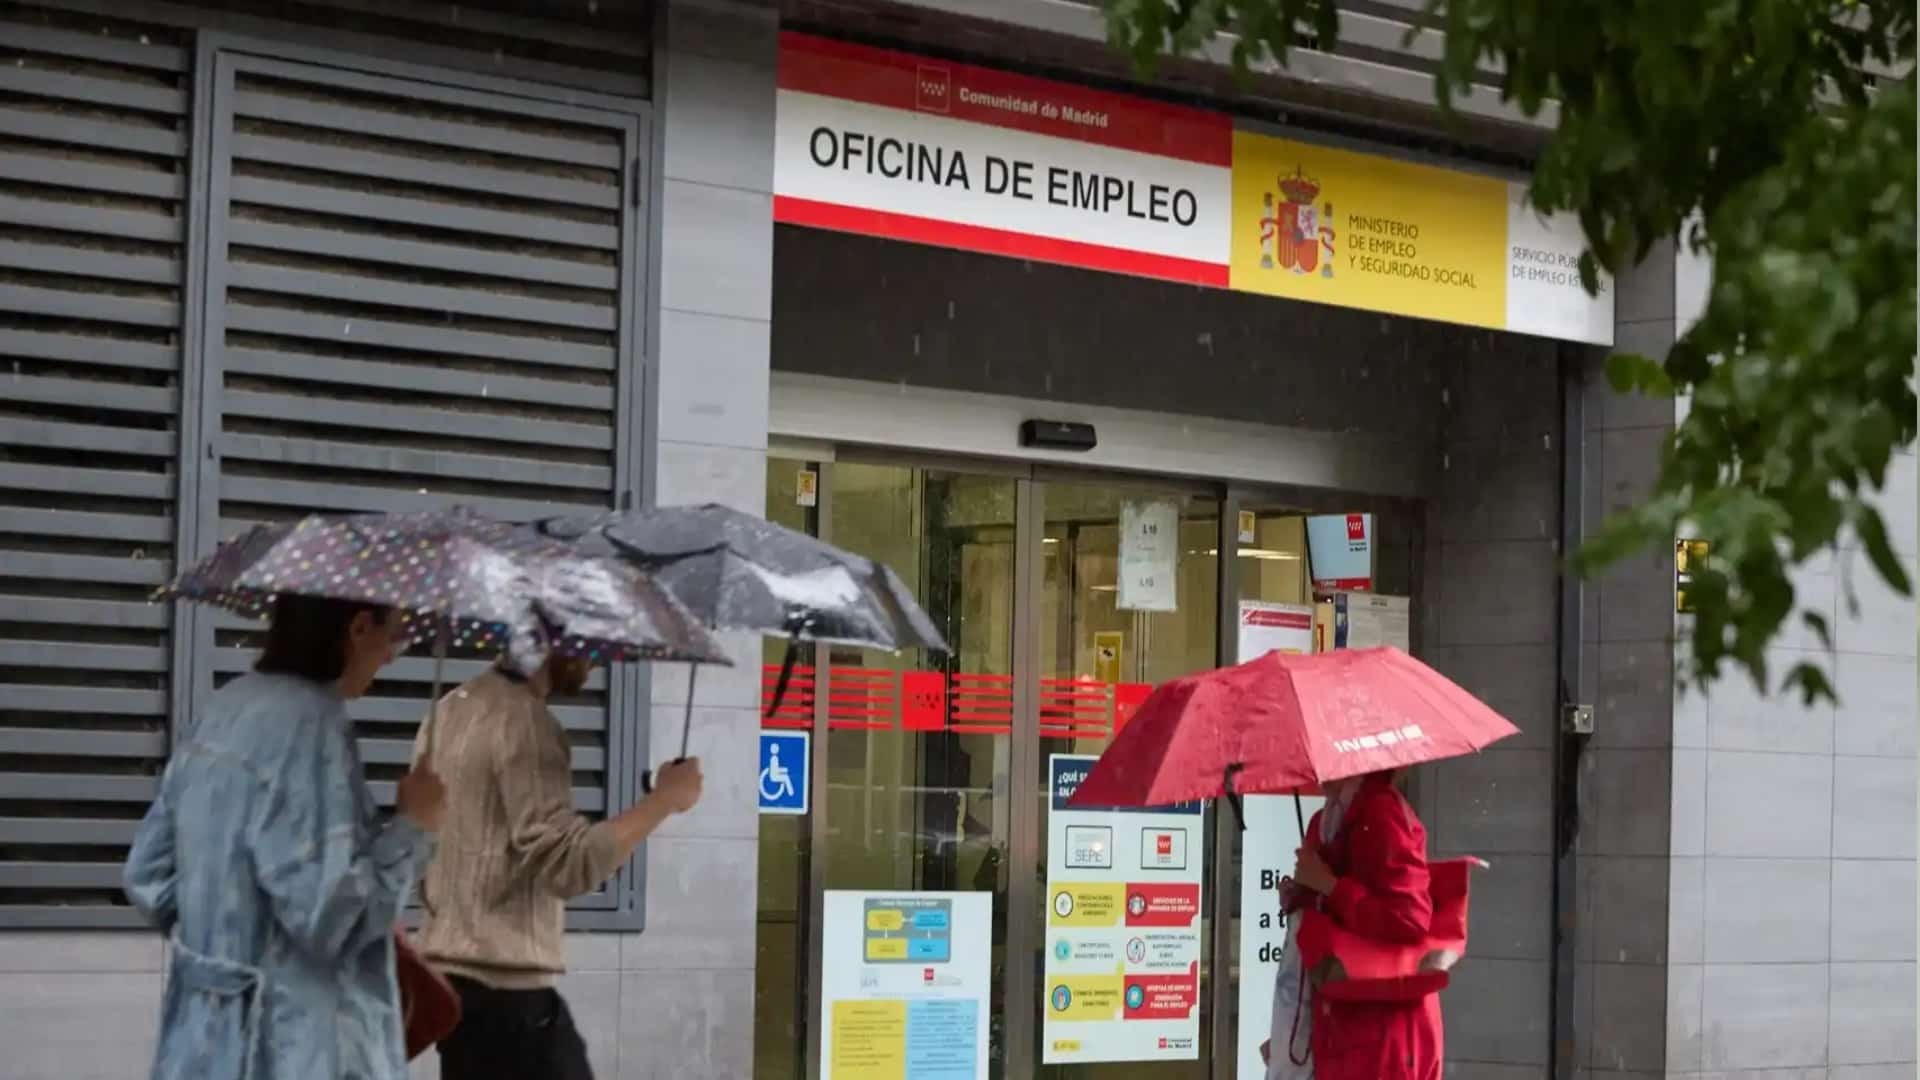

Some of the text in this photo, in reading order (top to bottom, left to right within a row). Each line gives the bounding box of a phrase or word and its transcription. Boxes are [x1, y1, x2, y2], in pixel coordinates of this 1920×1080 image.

[959, 87, 1109, 128] Comunidad de Madrid
[809, 126, 1198, 227] OFICINA DE EMPLEO
[1348, 214, 1419, 240] MINISTERIO
[1348, 234, 1417, 260] DE EMPLEO
[1511, 246, 1556, 265] SERVICIO
[1349, 255, 1477, 289] Y SEGURIDAD SOCIAL
[1511, 264, 1526, 280] DE
[1528, 267, 1566, 286] EMPLEO
[1074, 848, 1103, 863] SEPE
[1259, 913, 1271, 928] a
